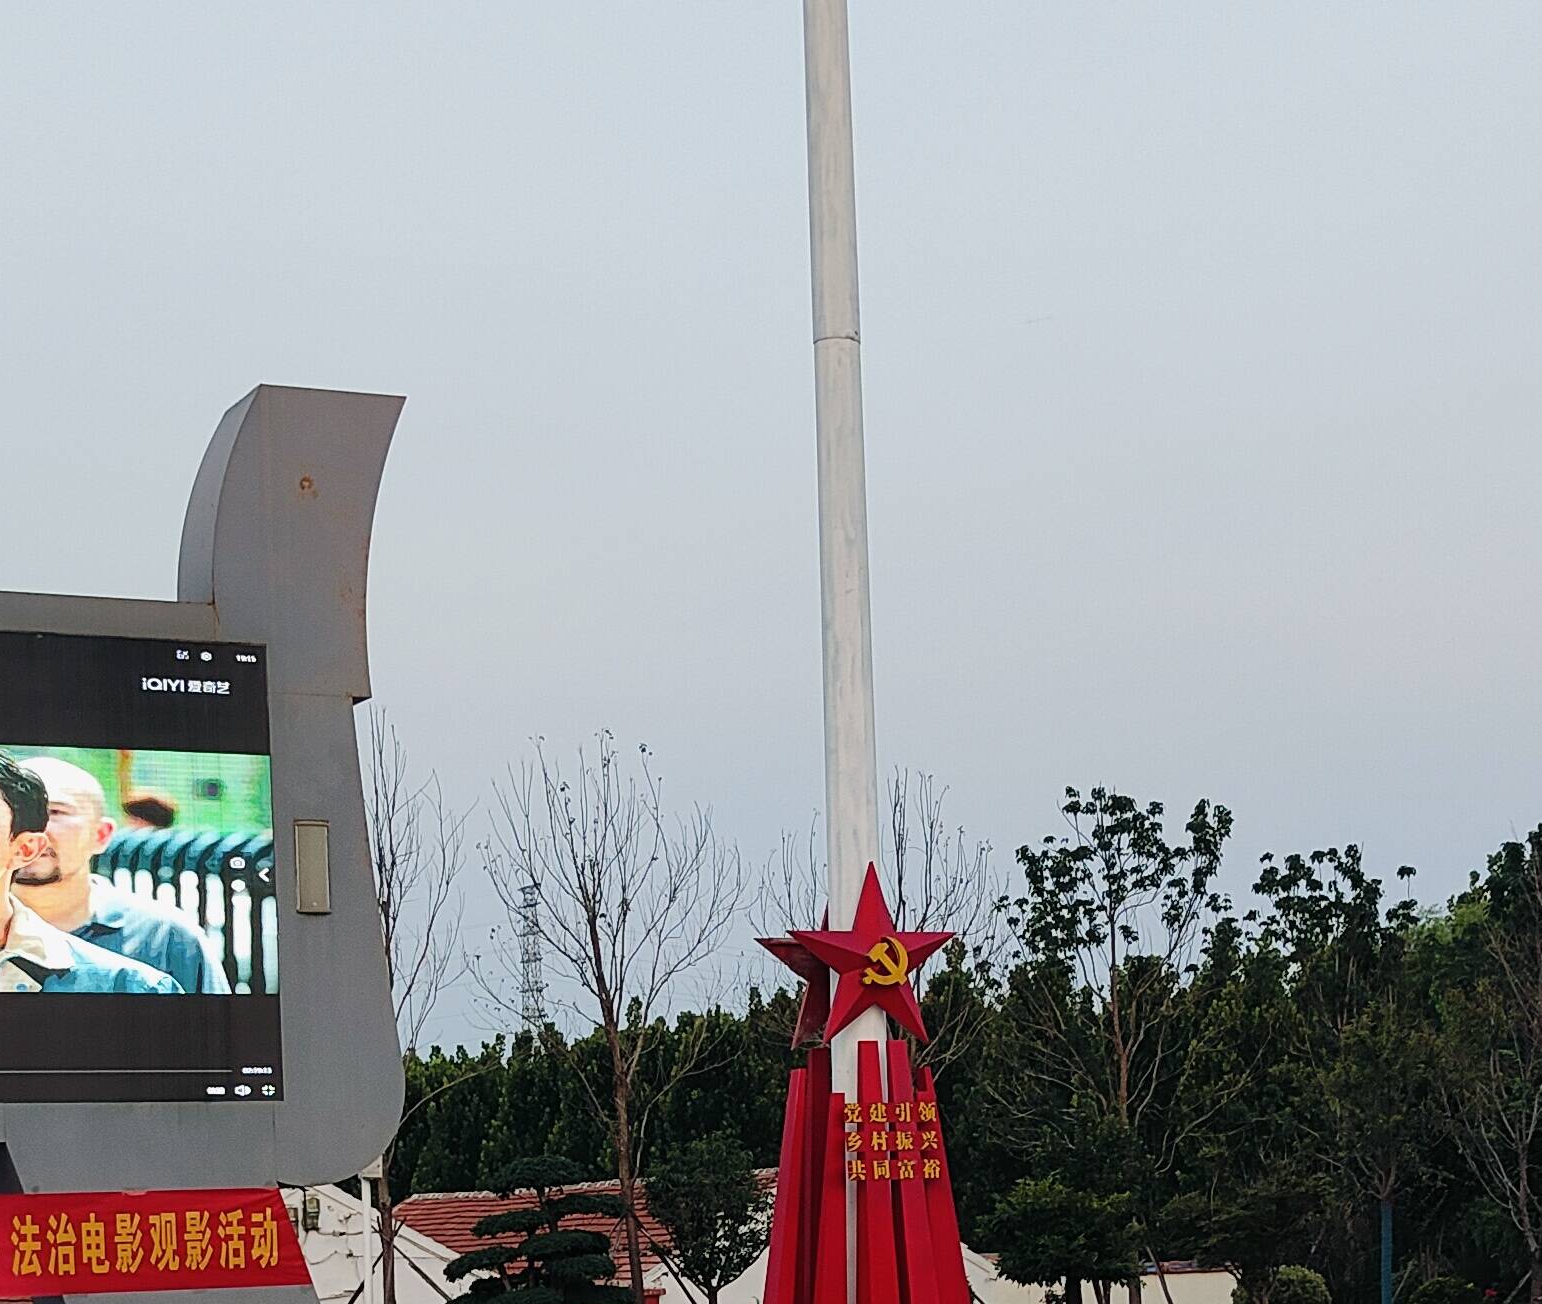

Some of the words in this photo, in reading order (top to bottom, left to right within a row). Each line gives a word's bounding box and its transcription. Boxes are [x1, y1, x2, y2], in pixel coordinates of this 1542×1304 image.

[142, 677, 185, 692] iQIYI
[187, 680, 230, 694] 爱奇艺
[844, 1102, 936, 1122] 党建引领
[847, 1131, 938, 1151] 乡村振兴
[849, 1160, 941, 1180] 共同富裕
